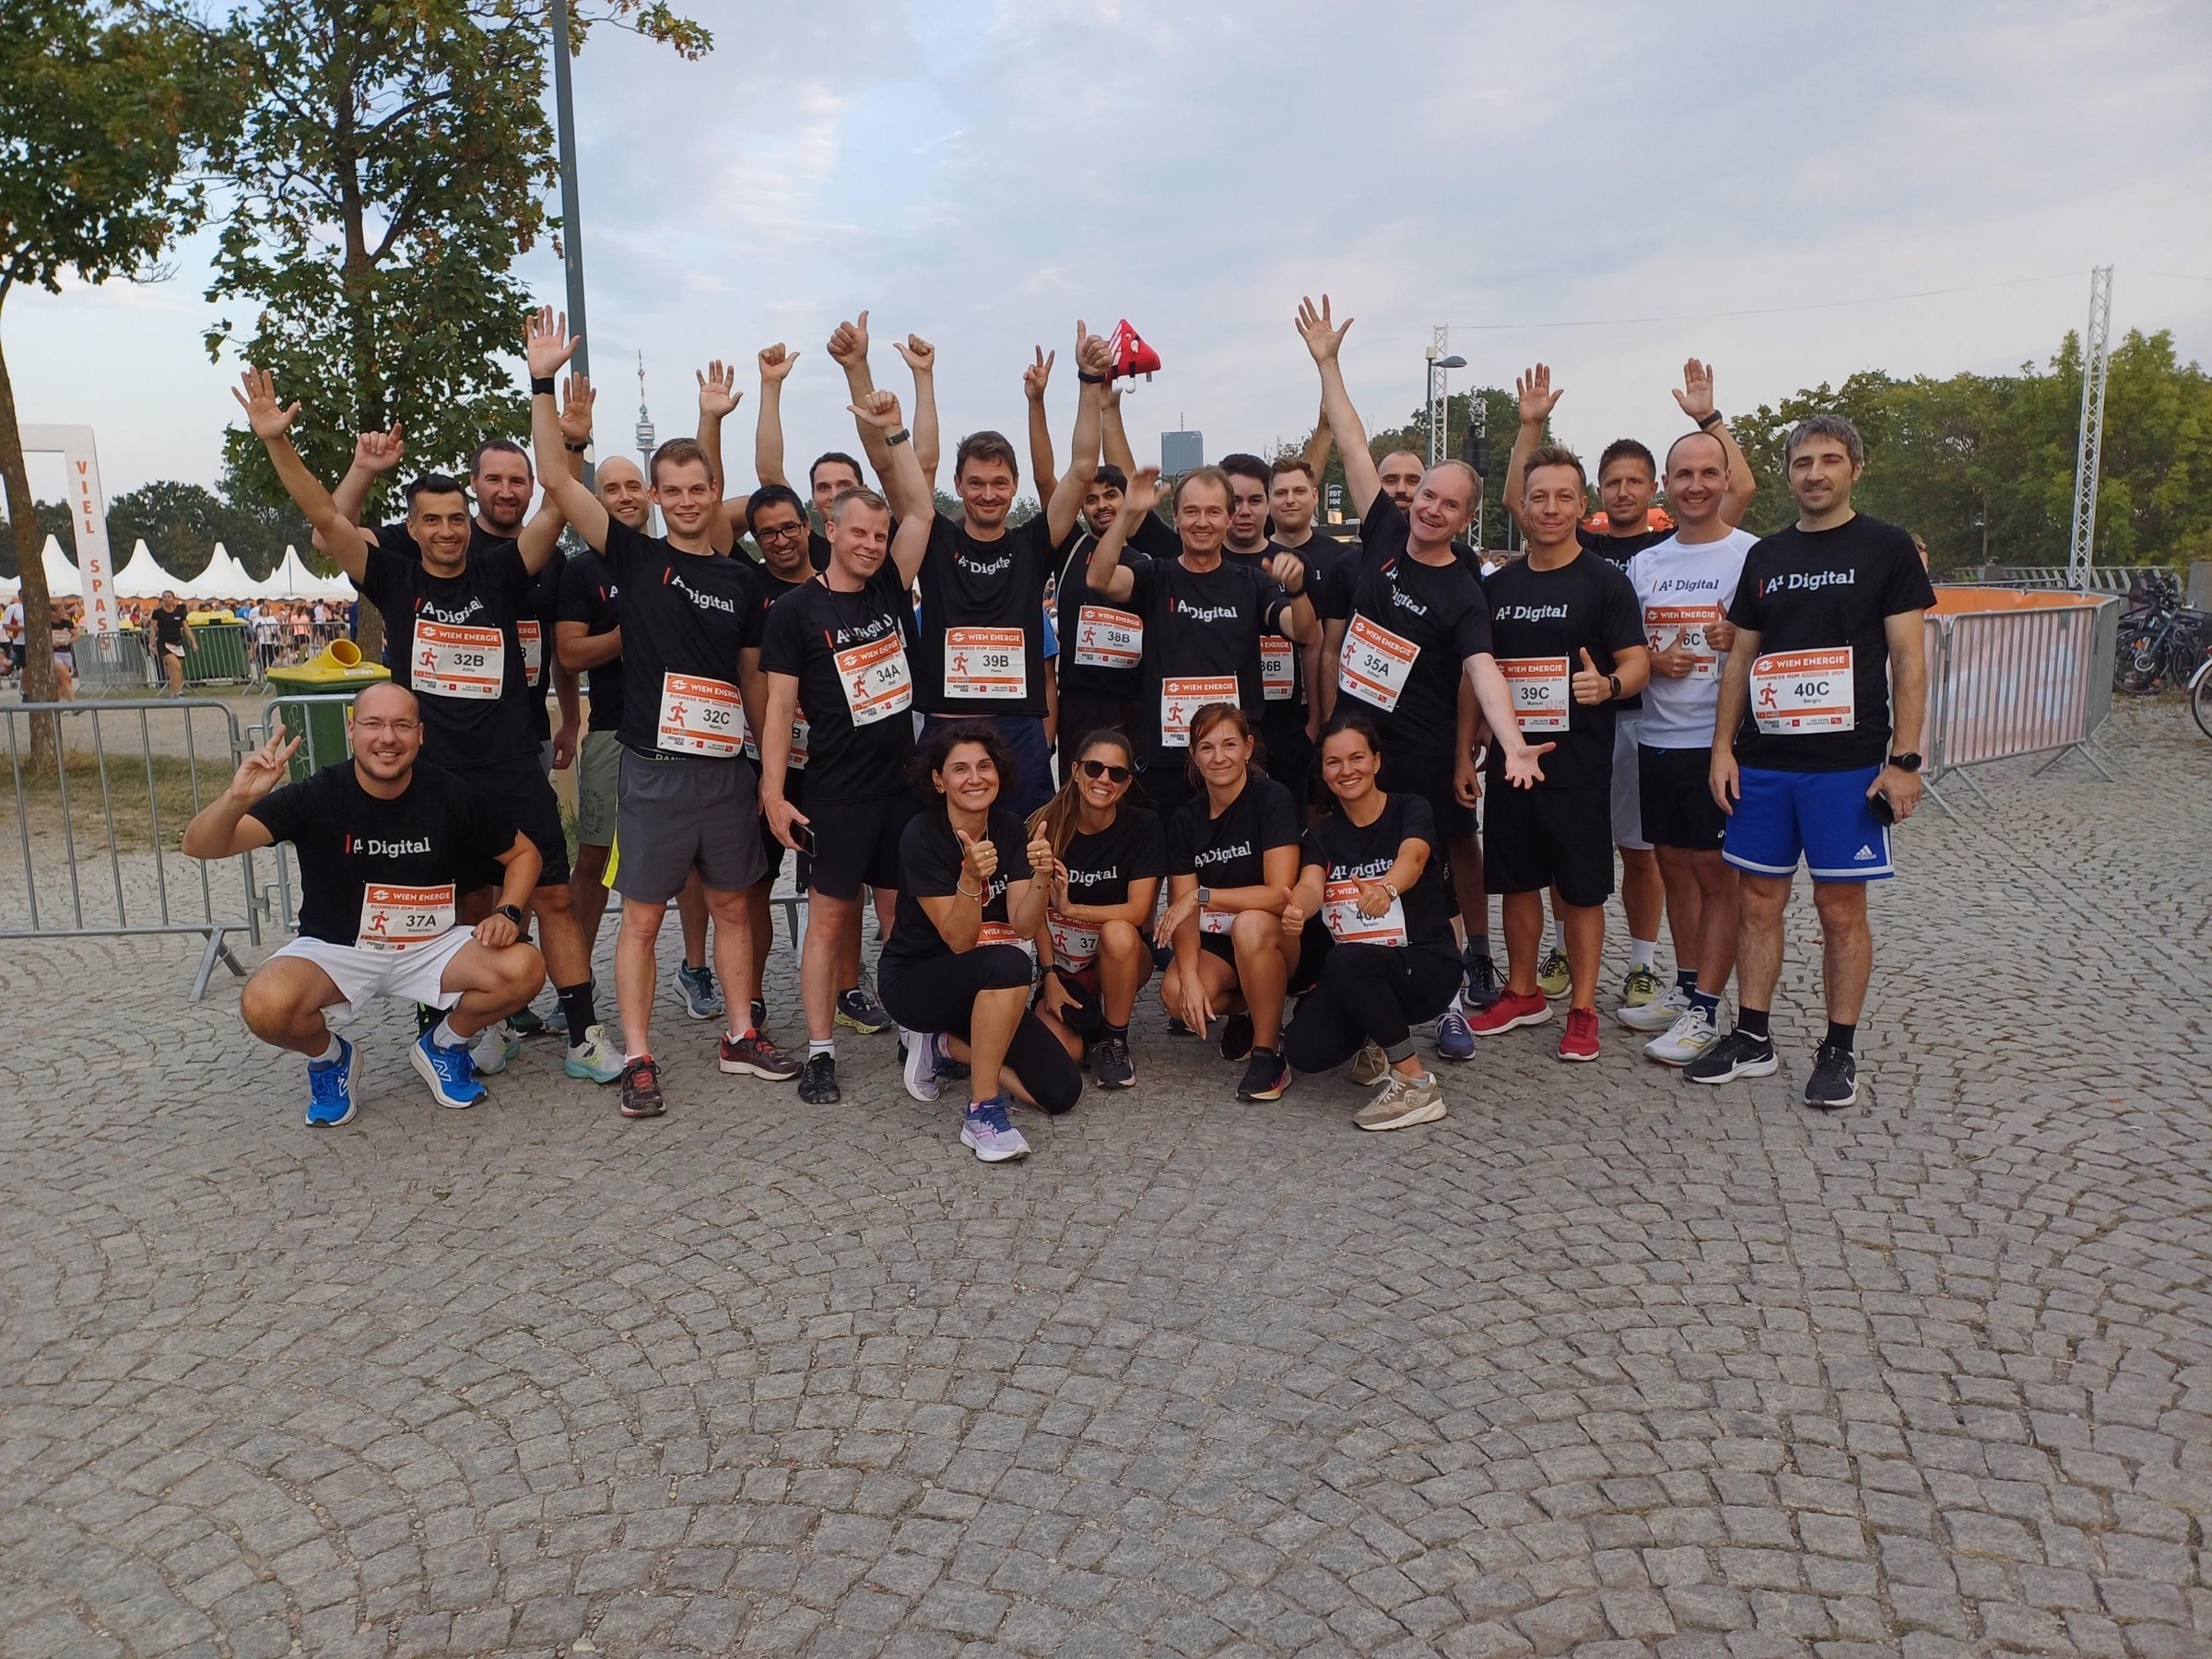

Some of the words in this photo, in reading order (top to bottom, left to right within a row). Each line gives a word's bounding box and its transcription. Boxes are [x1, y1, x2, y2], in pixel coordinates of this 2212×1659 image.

[76, 461, 95, 535] VIEL
[1675, 579, 1720, 592] Digital
[1788, 569, 1855, 590] Digital
[1392, 584, 1428, 617] igital
[434, 595, 484, 624] Digial
[1512, 604, 1569, 622] Digital
[1660, 611, 1679, 619] WIEN
[1680, 610, 1715, 618] ENERGIE
[1098, 612, 1115, 620] WIEN
[1115, 616, 1140, 626] ENERGIE
[439, 629, 463, 640] WIEN
[464, 630, 499, 642] ENERGIE
[1107, 630, 1130, 643] 38B
[1366, 628, 1382, 643] WIEN
[1382, 637, 1413, 657] ENERGIE
[1677, 632, 1700, 646] 6C
[453, 653, 485, 667] 32B
[859, 649, 879, 661] WIEN
[982, 654, 1009, 667] 39B
[1776, 658, 1802, 668] WIEN
[1803, 655, 1845, 666] ENERGIE
[1364, 653, 1390, 677] 35A
[1528, 665, 1563, 673] ENERGIE
[876, 664, 900, 683] 34A
[690, 683, 713, 693] WIEN
[1204, 682, 1233, 690] ENERGIE
[1794, 681, 1830, 697] 40C
[1521, 687, 1549, 700] 39C
[702, 708, 731, 725] 32C
[368, 837, 431, 858] Digital
[1329, 865, 1347, 880] A1
[393, 891, 418, 901] WIEN
[418, 890, 451, 901] ENERGIE
[1337, 887, 1359, 896] WIEN
[406, 914, 437, 927] 37A
